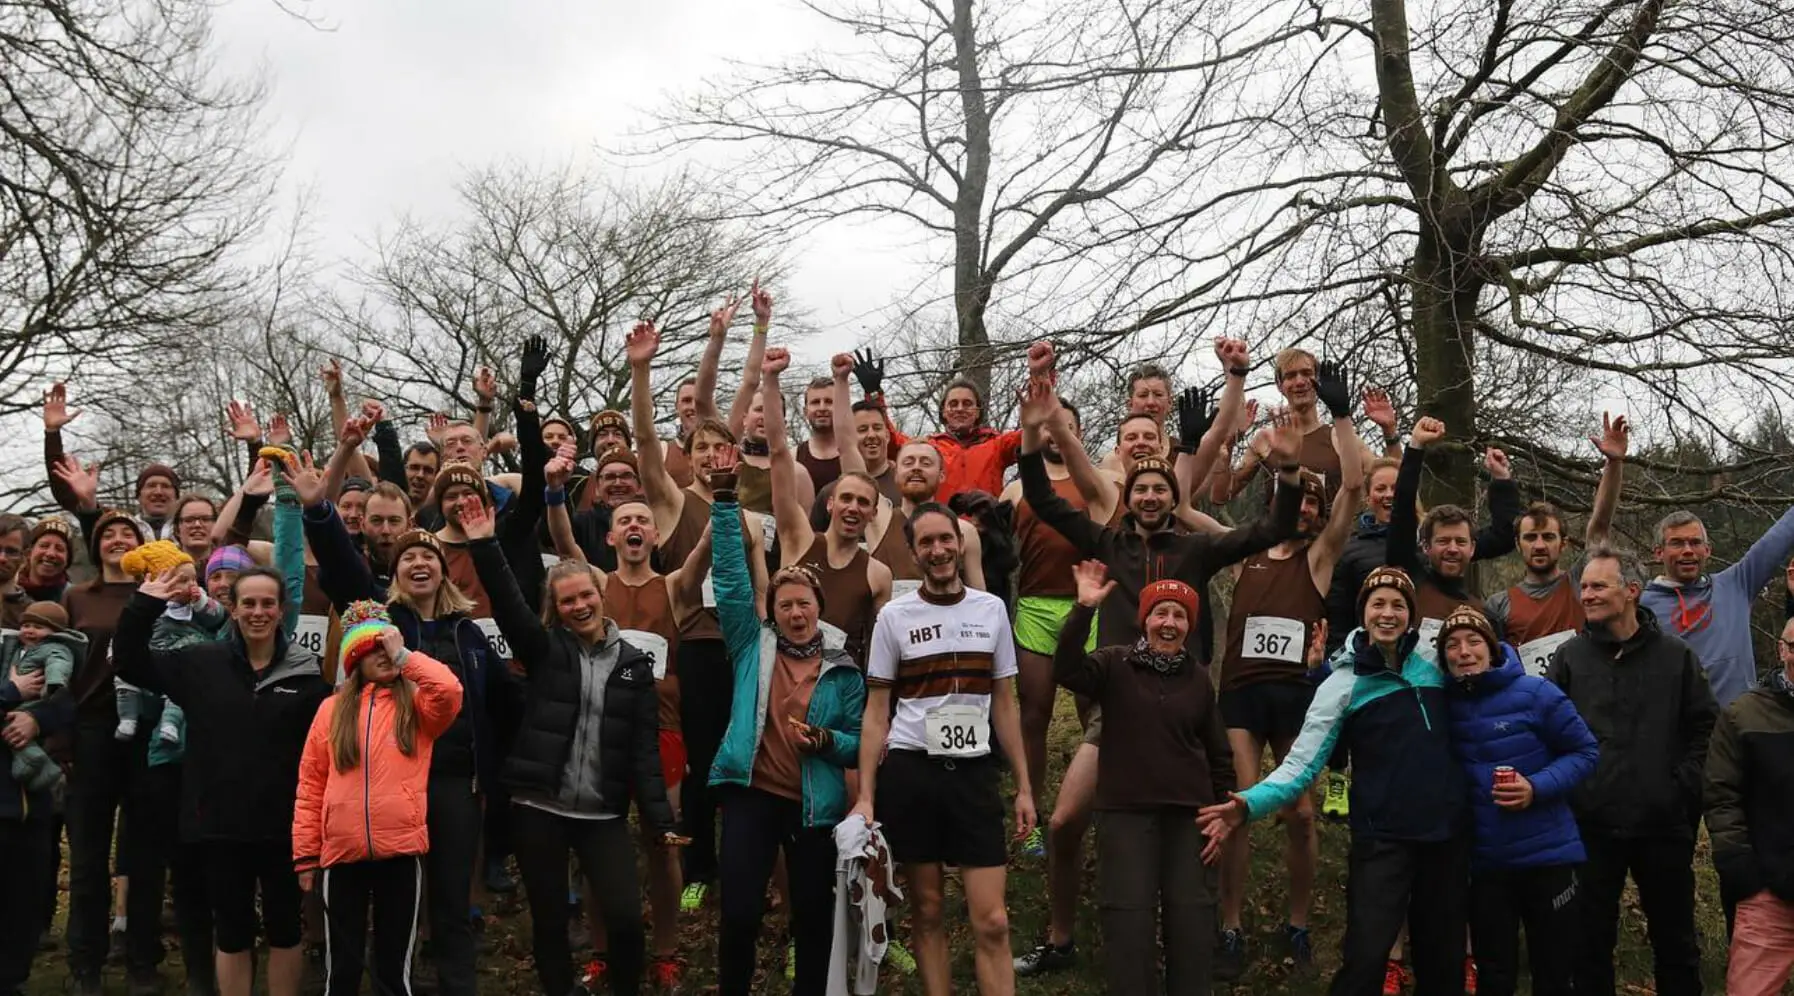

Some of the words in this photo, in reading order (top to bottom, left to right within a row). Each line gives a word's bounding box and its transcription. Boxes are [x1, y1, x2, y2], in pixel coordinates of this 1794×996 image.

[1138, 460, 1169, 472] HBT
[451, 473, 480, 489] HBT
[1369, 574, 1405, 587] HBT
[1156, 583, 1188, 595] HBT
[1446, 614, 1482, 629] HBT
[909, 624, 943, 645] HBT
[1254, 633, 1292, 655] 367
[940, 725, 977, 749] 384
